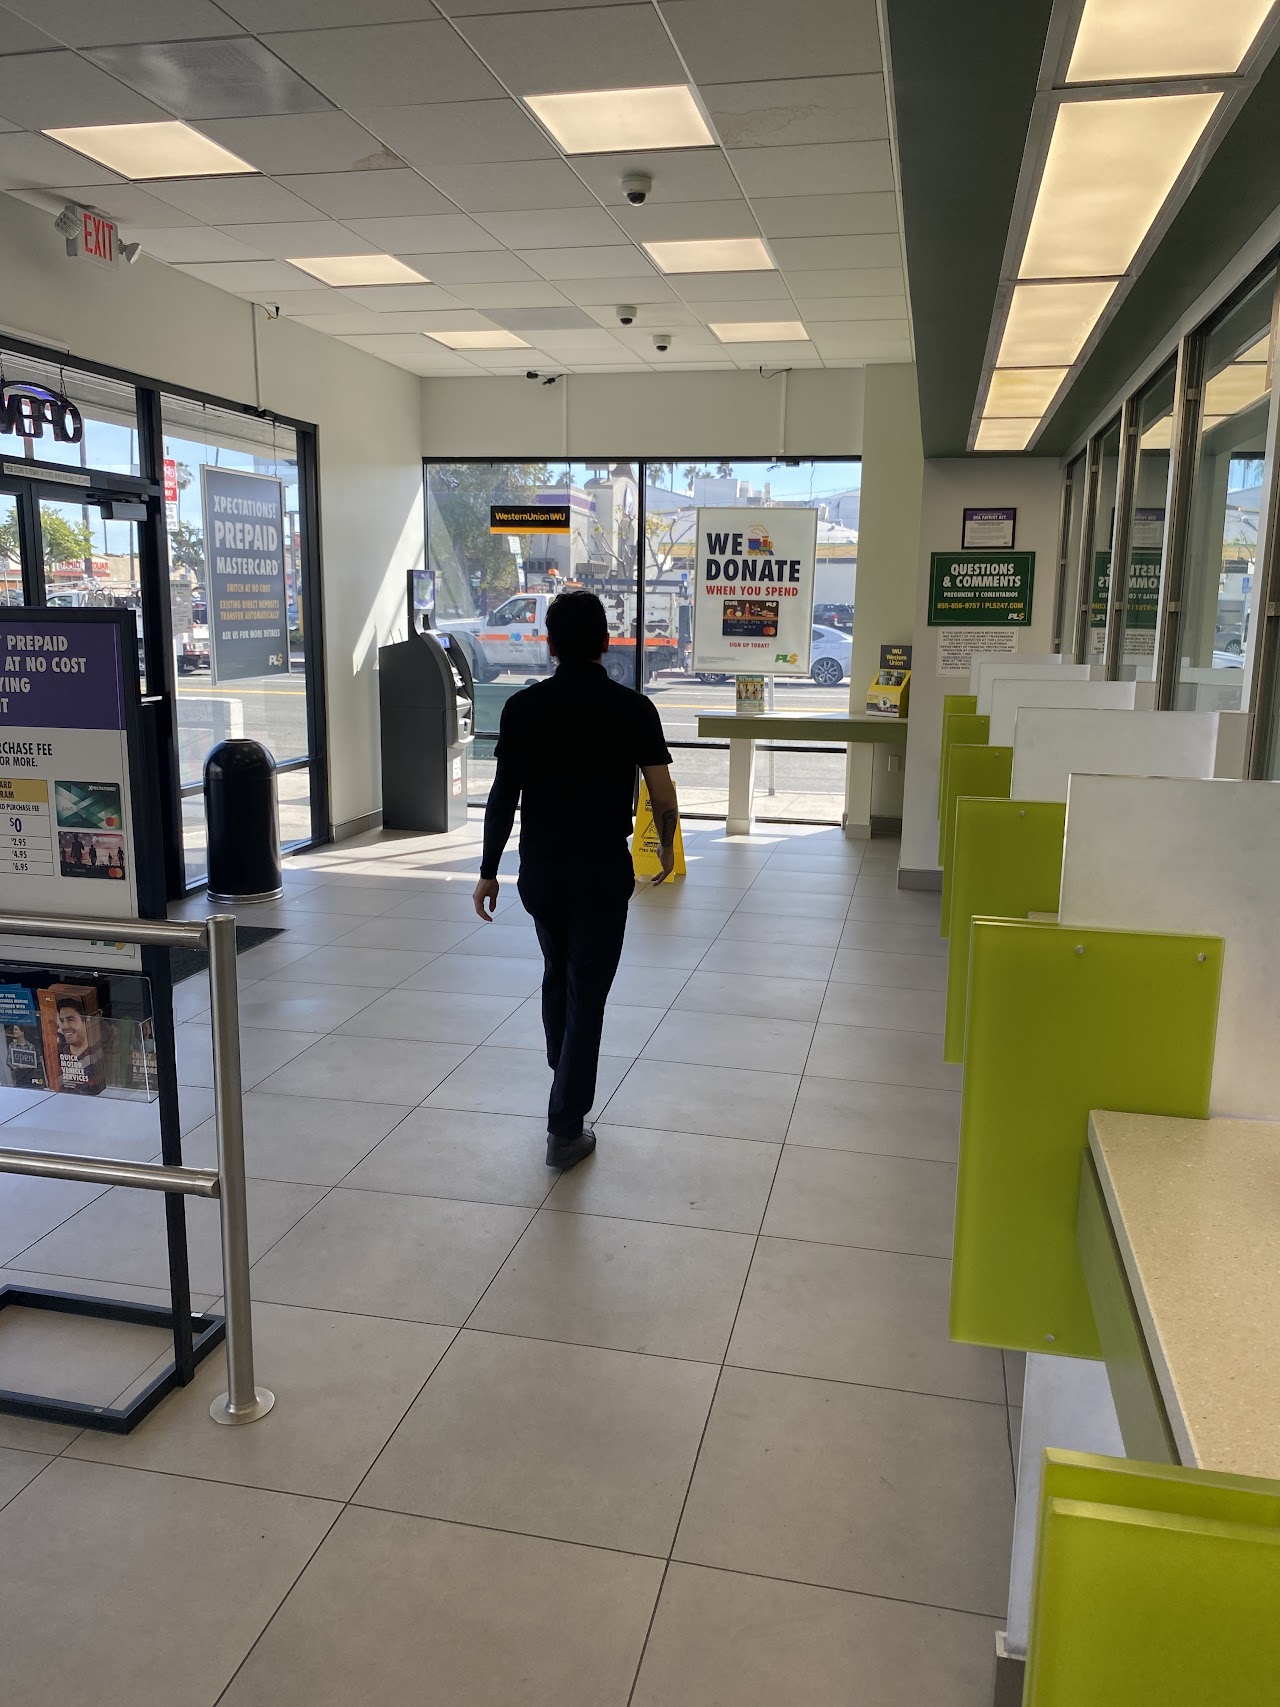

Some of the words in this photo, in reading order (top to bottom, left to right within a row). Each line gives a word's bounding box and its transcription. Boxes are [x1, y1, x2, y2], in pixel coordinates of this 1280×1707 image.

[83, 212, 113, 262] EXIT
[214, 520, 278, 552] PREPAID
[707, 533, 743, 555] WE
[706, 559, 801, 582] DONATE
[951, 563, 1014, 576] QUESTIONS
[227, 584, 244, 592] SWITCH
[245, 584, 251, 592] AT
[252, 584, 259, 592] NO
[260, 584, 271, 592] COST
[943, 576, 952, 587] &
[956, 576, 1021, 588] COMMENTS
[706, 586, 736, 595] WHEN
[740, 586, 761, 596] YOU
[765, 587, 798, 597] SPEND
[220, 600, 241, 608] EXISTING
[242, 600, 258, 608] DIRECT
[259, 600, 279, 608] DEPOSITS
[220, 611, 243, 620] TRANSFER
[244, 611, 279, 619] AUTOMATICALLY
[222, 631, 231, 640] ASK
[232, 631, 239, 639] US
[240, 630, 249, 639] FOR
[250, 630, 262, 638] MORE
[263, 629, 280, 637] DETAILS
[7, 635, 68, 651] PREPAID
[5, 656, 20, 671] AT
[26, 657, 47, 672] NO
[52, 657, 87, 673] COST
[37, 743, 53, 756] FEE
[13, 757, 38, 767] MORE.
[9, 817, 22, 832] $0
[62, 1067, 84, 1075] VEHICLE
[63, 1073, 89, 1082] SERVICES
